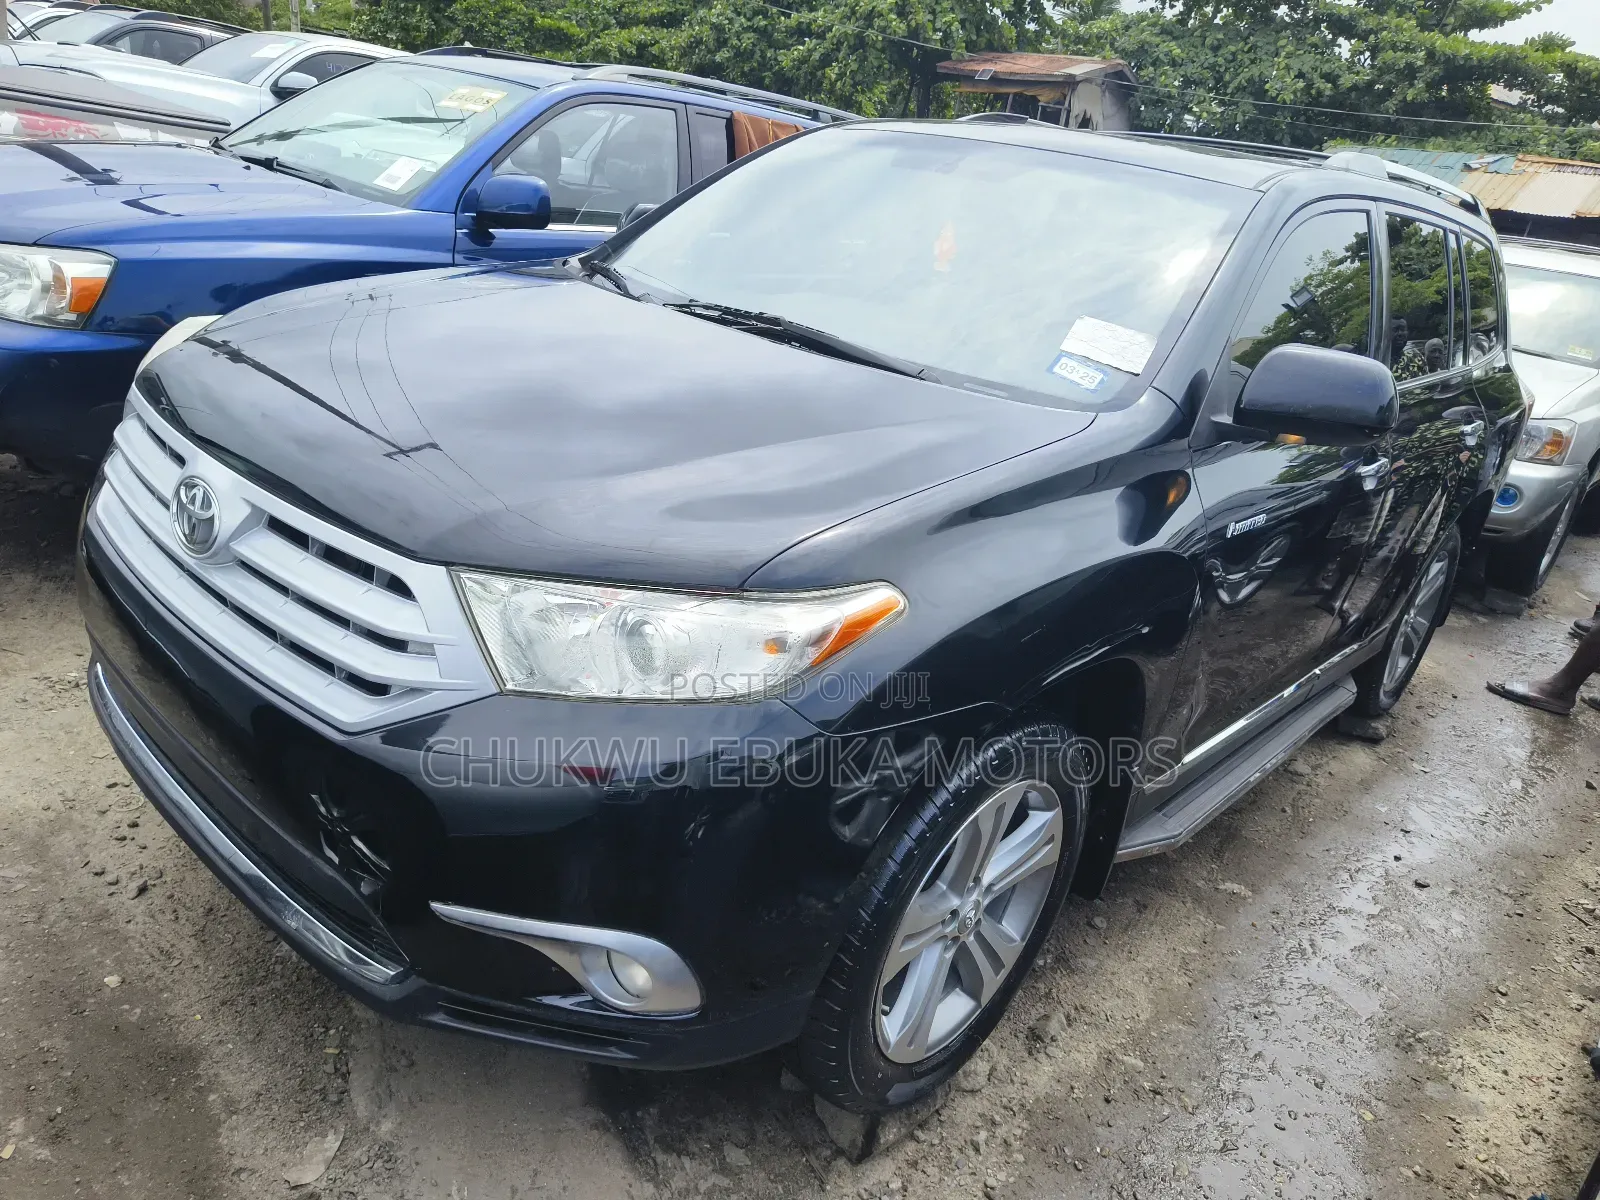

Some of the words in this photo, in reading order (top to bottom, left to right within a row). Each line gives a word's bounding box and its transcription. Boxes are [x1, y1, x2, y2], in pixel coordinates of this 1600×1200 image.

[448, 94, 493, 105] LAGOS
[1059, 362, 1076, 375] 03
[1078, 371, 1098, 384] 25
